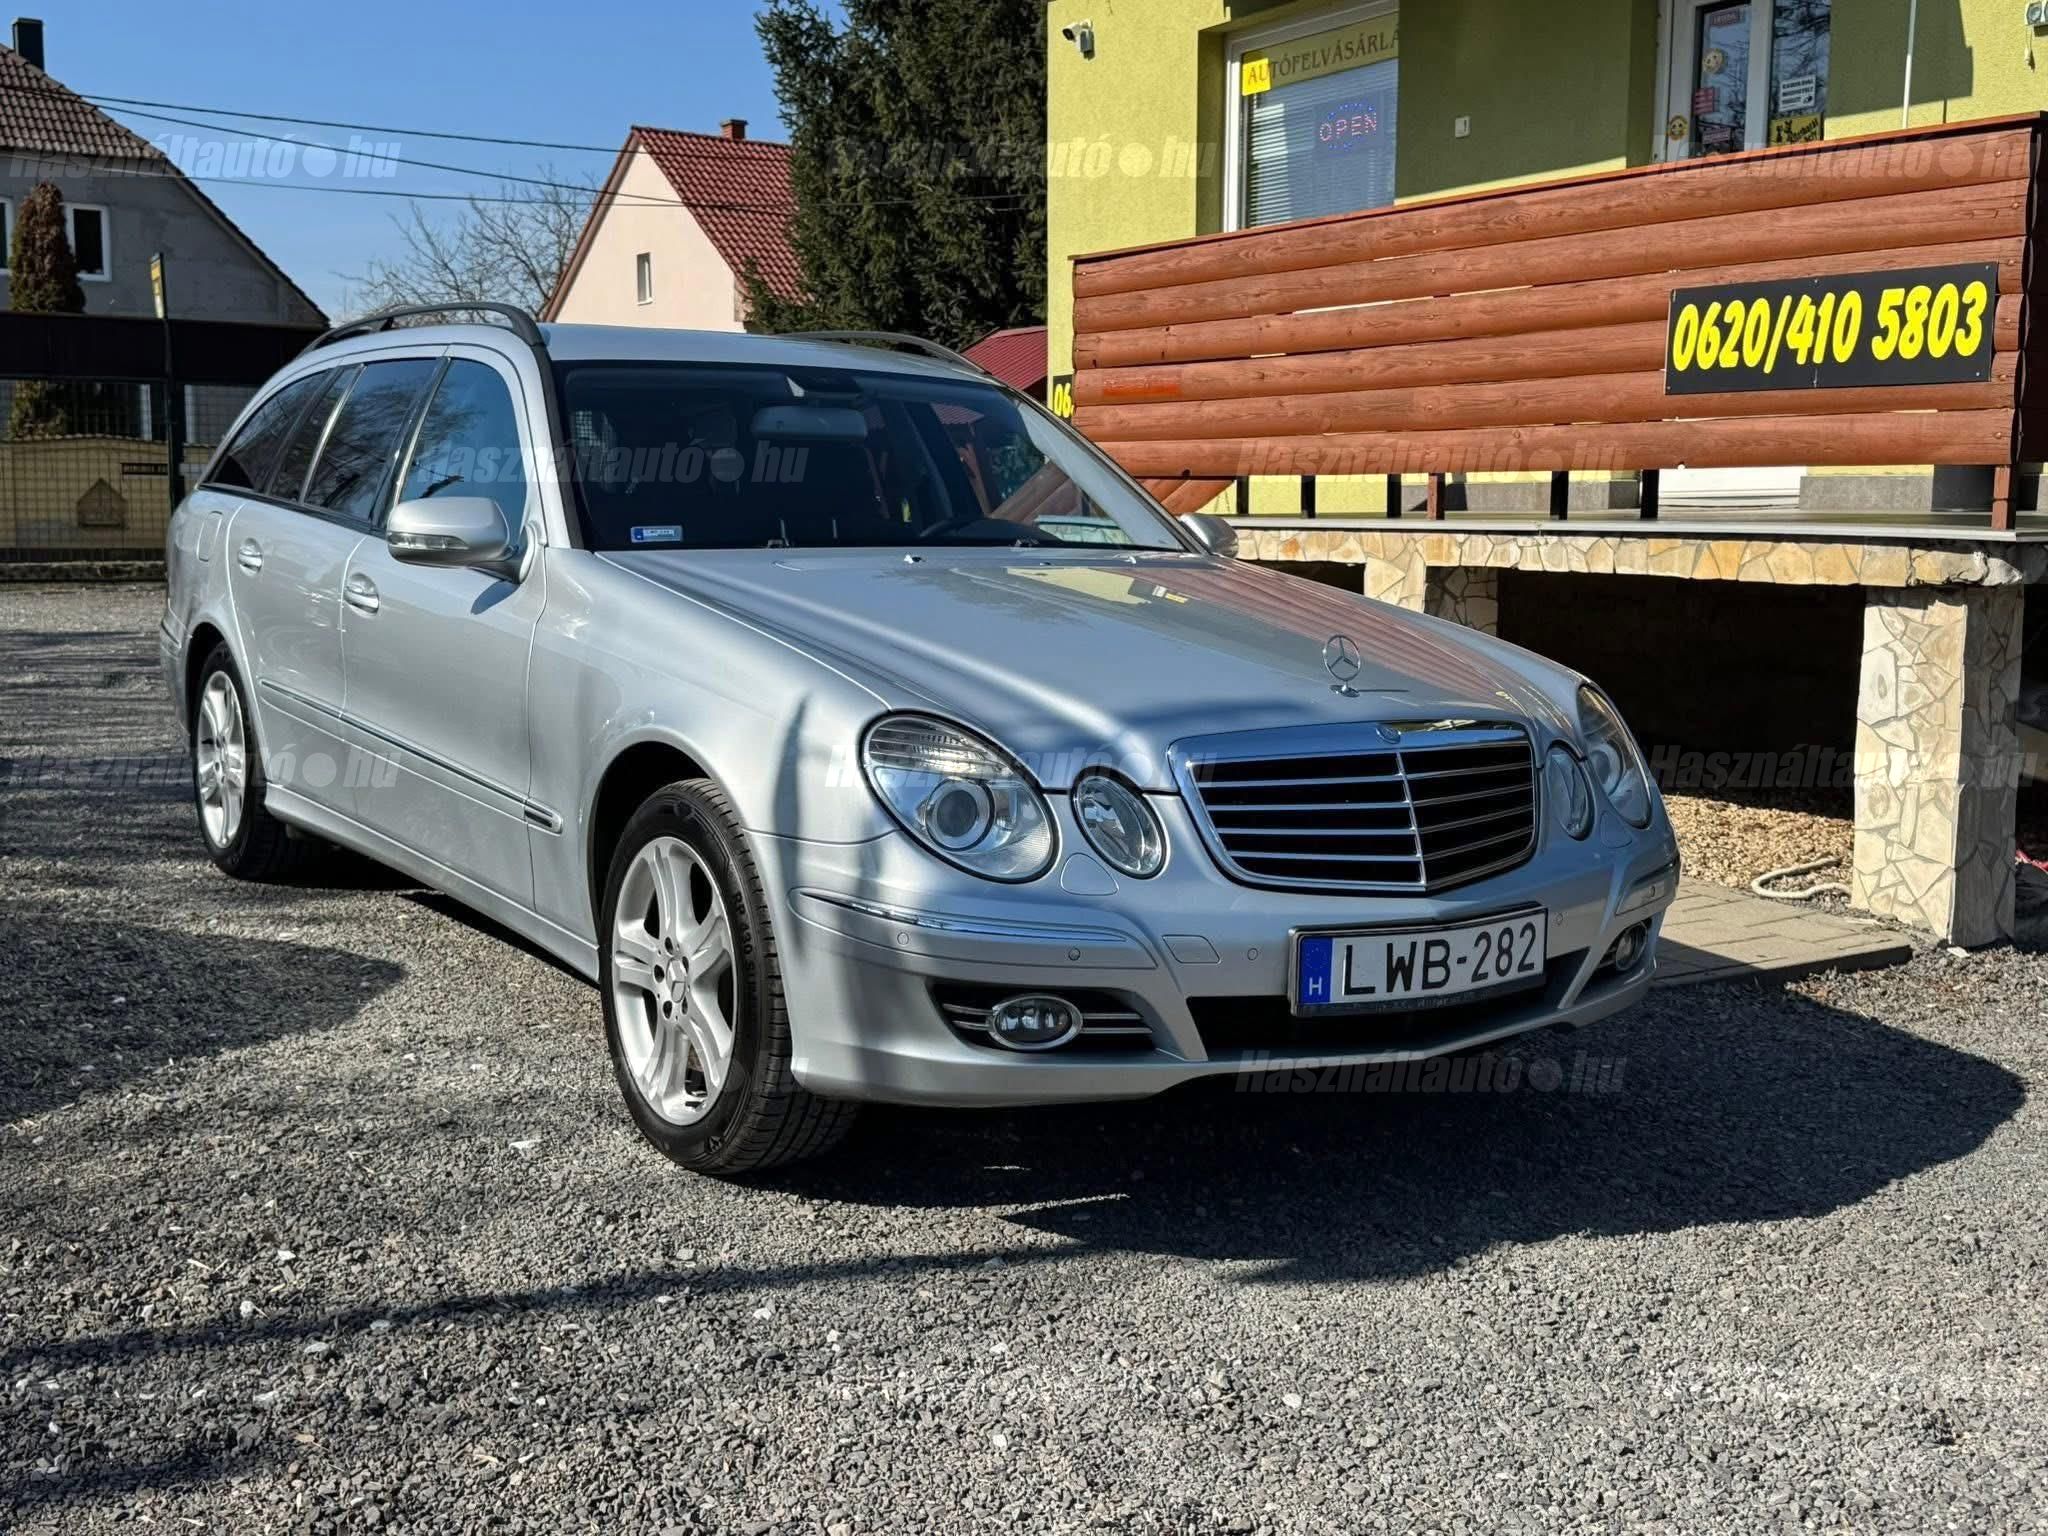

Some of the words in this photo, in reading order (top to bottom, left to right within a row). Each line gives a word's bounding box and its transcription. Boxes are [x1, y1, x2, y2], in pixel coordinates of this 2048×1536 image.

[1319, 112, 1377, 142] OPEN
[1672, 289, 1862, 374] 0620/410
[1871, 280, 1988, 361] 5803
[1053, 382, 1074, 418] 06
[1308, 976, 1323, 996] H
[1343, 921, 1537, 996] LWB-282
